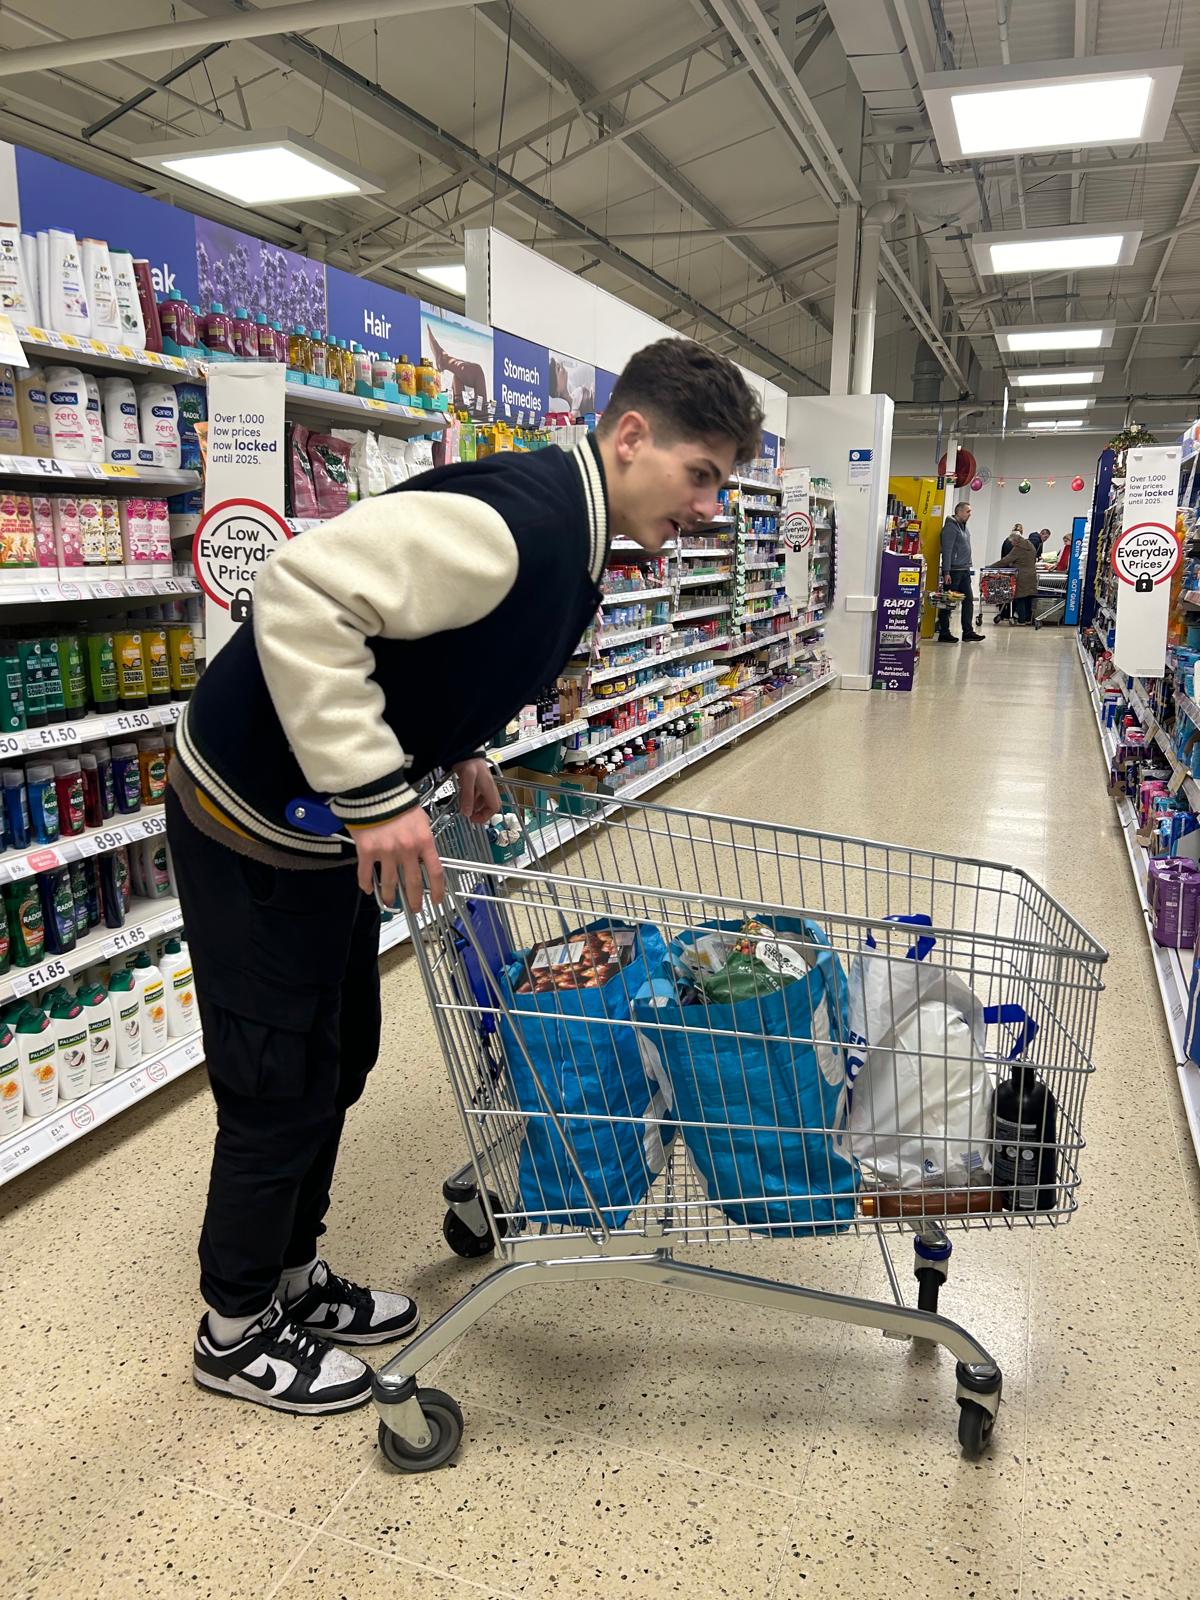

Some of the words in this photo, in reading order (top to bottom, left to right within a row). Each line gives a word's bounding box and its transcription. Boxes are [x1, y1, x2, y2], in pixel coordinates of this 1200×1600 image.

[114, 278, 131, 288] Dove
[151, 263, 176, 294] ak
[364, 309, 392, 340] Hair
[504, 357, 540, 386] Stomach
[53, 393, 76, 403] Sanex
[502, 384, 542, 411] Remedies
[54, 413, 78, 421] zero
[154, 408, 173, 416] Sanex
[183, 411, 200, 420] RADOX
[214, 413, 236, 424] Over
[238, 413, 264, 425] 1,000
[155, 424, 174, 432] zero
[213, 425, 229, 437] low
[231, 425, 261, 438] prices
[213, 441, 232, 451] now
[234, 438, 277, 452] locked
[113, 451, 130, 459] Sanex
[213, 454, 233, 464] until
[235, 454, 262, 465] 2025.
[37, 458, 62, 474] £4
[1129, 475, 1147, 483] Over
[1147, 474, 1167, 482] 1,000
[1142, 483, 1163, 492] prices
[1128, 491, 1144, 499] now
[1144, 489, 1174, 498] locked
[227, 525, 259, 542] Low
[1136, 537, 1158, 547] Low
[200, 539, 276, 566] Everyda
[1117, 546, 1176, 561] Everyday
[1128, 560, 1162, 570] Prices
[218, 565, 258, 582] Price
[166, 580, 179, 591] £1
[883, 599, 916, 608] RAPID
[894, 618, 907, 626] just
[170, 706, 181, 719] £1
[117, 712, 150, 730] £1.50
[40, 727, 77, 744] £1.50
[0, 738, 18, 753] 50
[94, 831, 123, 850] 89p
[57, 901, 74, 913] RADOX
[23, 911, 42, 923] RADOX
[113, 927, 146, 950] £1.85
[28, 961, 66, 987] £1.85
[122, 1004, 139, 1016] PALMOL
[89, 1019, 111, 1031] LMOLIVE
[59, 1032, 86, 1045] PALMOLIVE
[14, 1145, 30, 1158] £1.20
